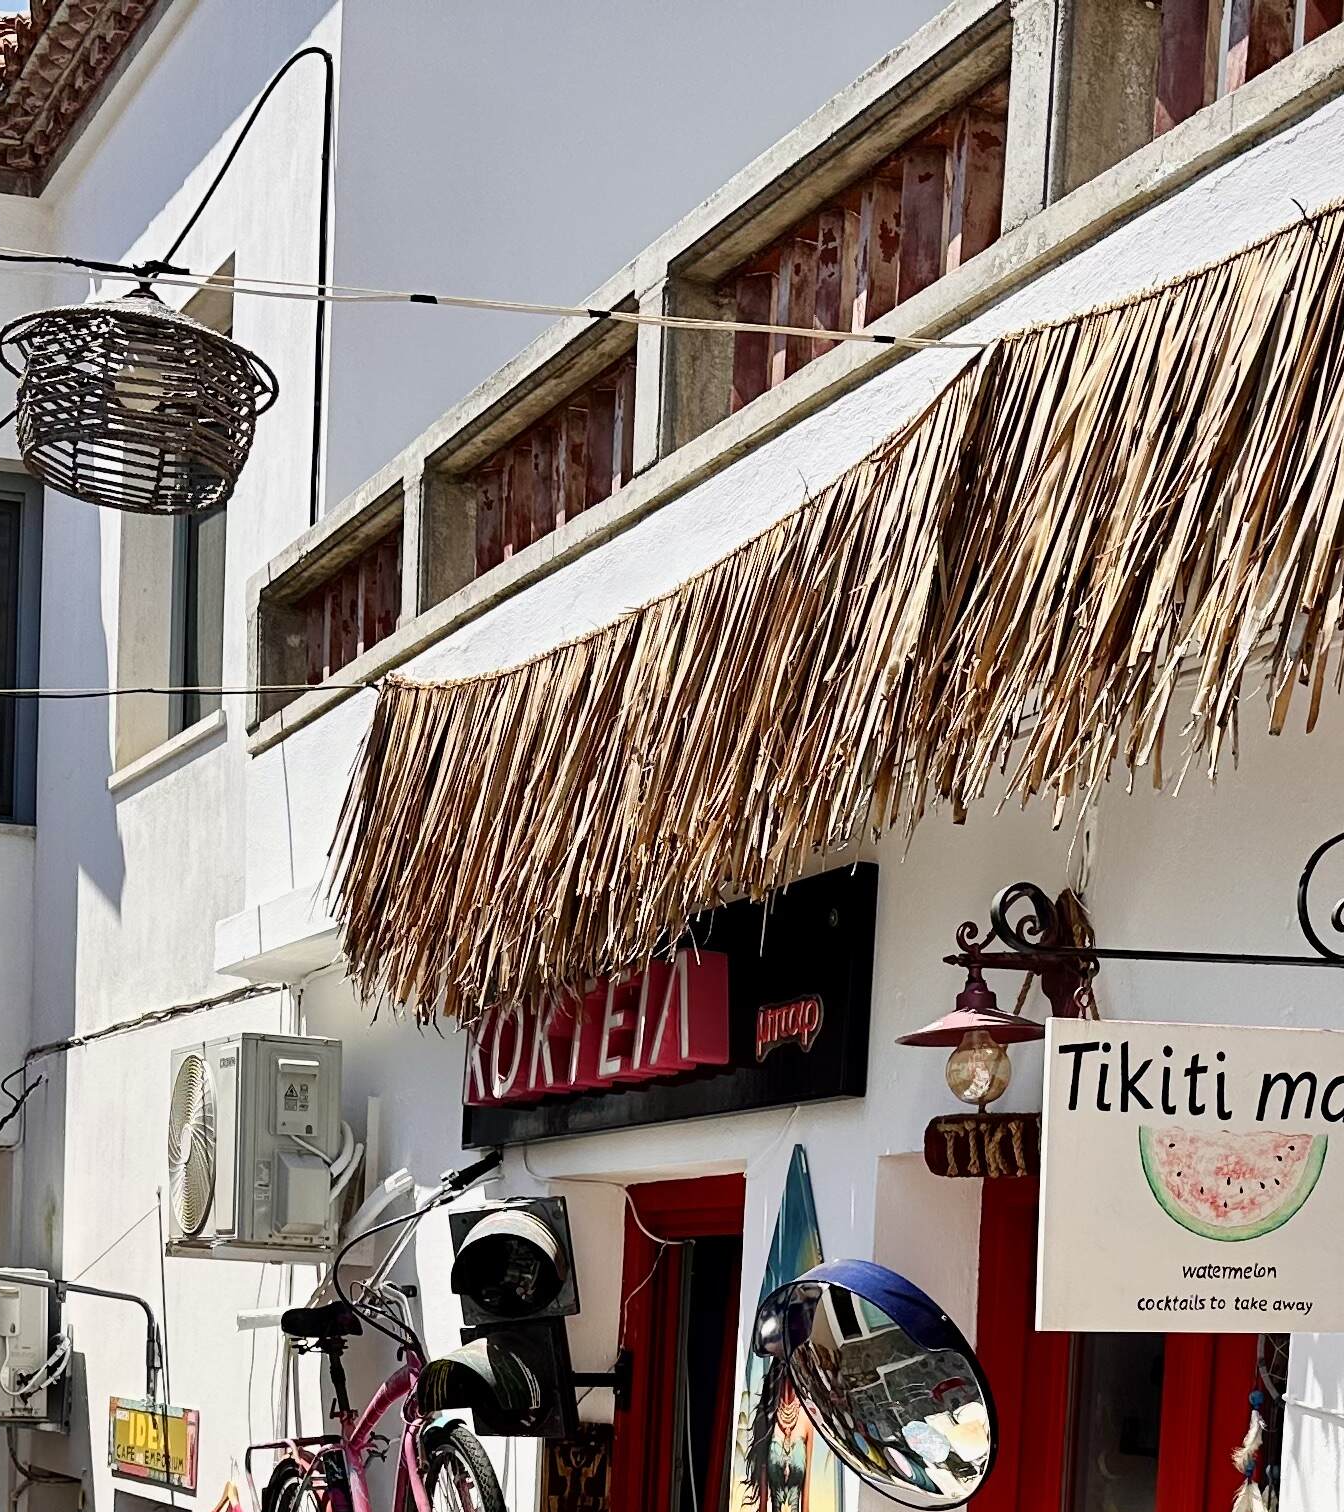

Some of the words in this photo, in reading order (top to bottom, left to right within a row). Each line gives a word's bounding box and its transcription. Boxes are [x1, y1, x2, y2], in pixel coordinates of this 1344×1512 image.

[1058, 1040, 1234, 1121] Tikiti
[1182, 1263, 1277, 1280] watermelon
[1136, 1294, 1206, 1312] cocktails
[1210, 1296, 1226, 1311] to
[1234, 1297, 1268, 1312] take
[1272, 1300, 1314, 1316] away
[144, 1449, 184, 1472] EMPOIUM
